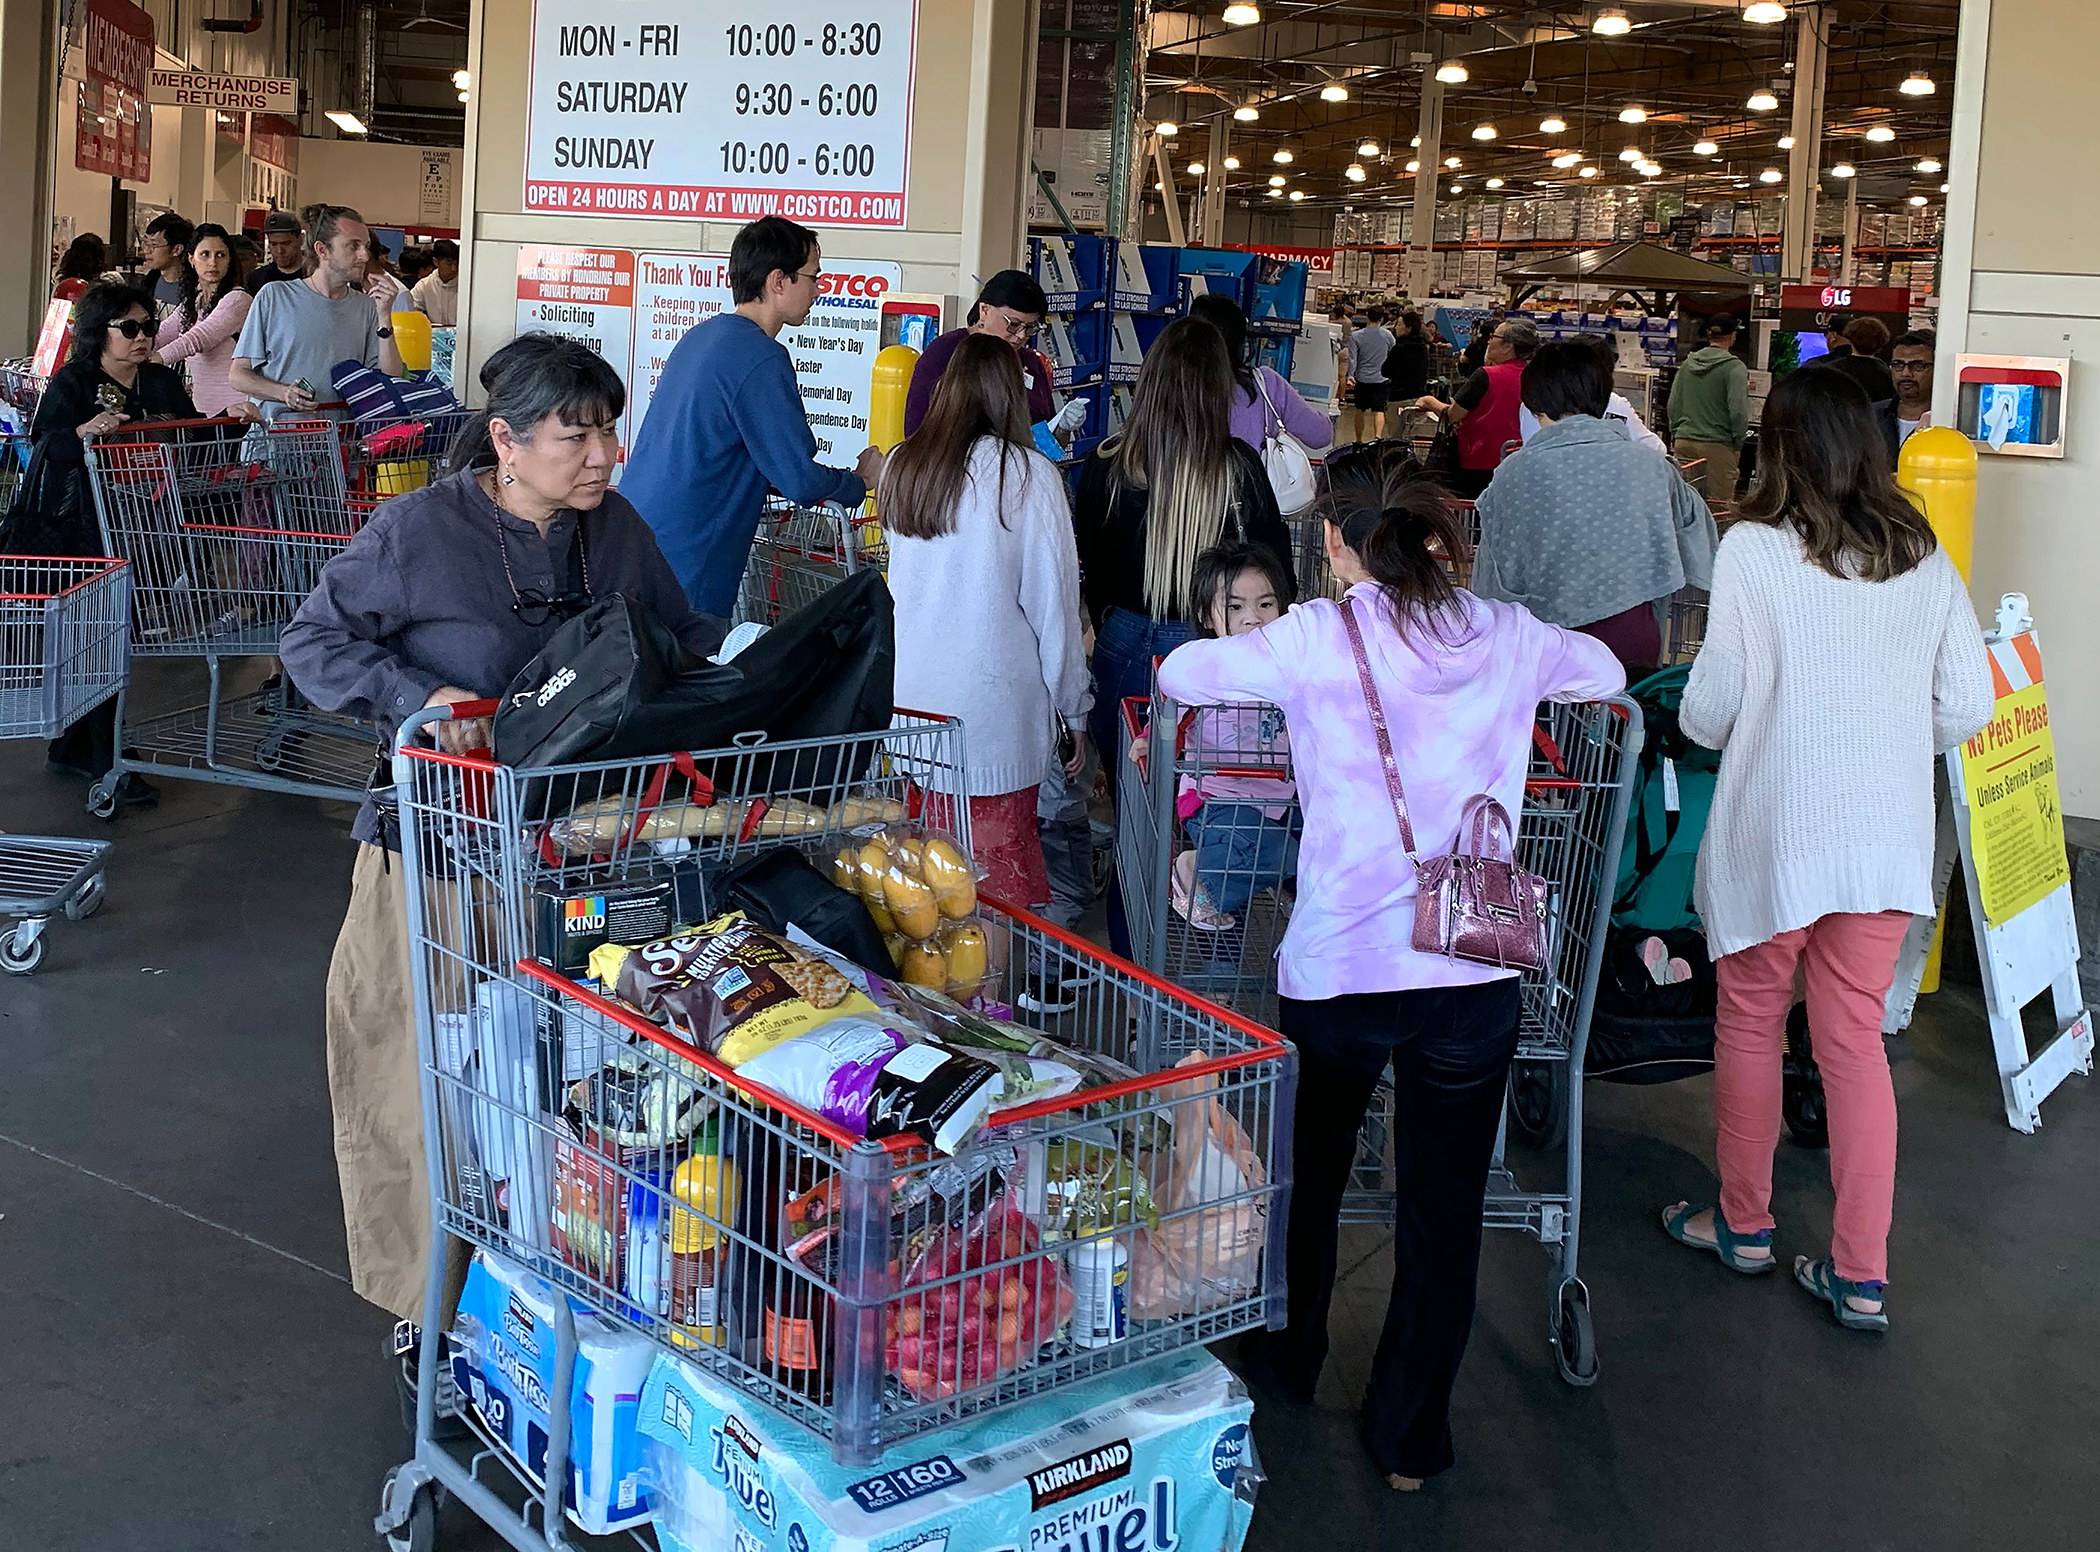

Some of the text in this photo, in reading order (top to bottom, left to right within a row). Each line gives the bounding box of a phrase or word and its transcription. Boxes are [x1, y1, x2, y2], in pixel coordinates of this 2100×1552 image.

[559, 25, 616, 57] MON
[639, 24, 679, 57] FRI
[725, 23, 796, 57] 10:00
[821, 22, 882, 56] 8:30
[151, 72, 292, 96] MERCHANDISE
[176, 89, 267, 109] RETURNS
[557, 82, 689, 114] SATURDAY
[735, 83, 792, 116] 9:30
[818, 83, 878, 117] 6:00
[554, 136, 655, 170] SUNDAY
[719, 141, 790, 175] 10:00
[814, 143, 874, 177] 6:00
[429, 164, 439, 175] E
[528, 185, 901, 220] OPEN 24 HOURS A DAY AT WWW.COSTCO.COM
[538, 251, 616, 268] PLEASE RESPECT OUR
[521, 266, 631, 286] MEMBERS BY HONORING OUR
[643, 261, 732, 288] Thank You Fo
[817, 273, 889, 297] STCO
[539, 284, 610, 302] PRIVATE PROPERTY
[812, 296, 878, 310] WHOLESAL
[1833, 289, 1851, 306] LG
[540, 304, 595, 328] Soliciting
[698, 302, 721, 314] your
[652, 313, 695, 326] children
[652, 328, 662, 340] at
[665, 328, 678, 341] all
[797, 334, 864, 355] New Year's Day
[796, 358, 823, 374] Easter
[836, 387, 852, 404] Day
[851, 415, 867, 432] Day
[817, 437, 833, 454] Day
[537, 668, 578, 707] adidas
[1987, 714, 2014, 751] Pets
[2013, 703, 2049, 739] Please
[1976, 754, 2054, 808] Unless Service Animals
[564, 915, 606, 933] KIND
[518, 1360, 552, 1415] Tiss
[897, 1460, 952, 1489] 160
[1032, 1445, 1130, 1496] KIRKLAND
[856, 1479, 893, 1501] 12
[868, 1494, 898, 1508] ROLLS
[1031, 1489, 1134, 1545] PREMIUM
